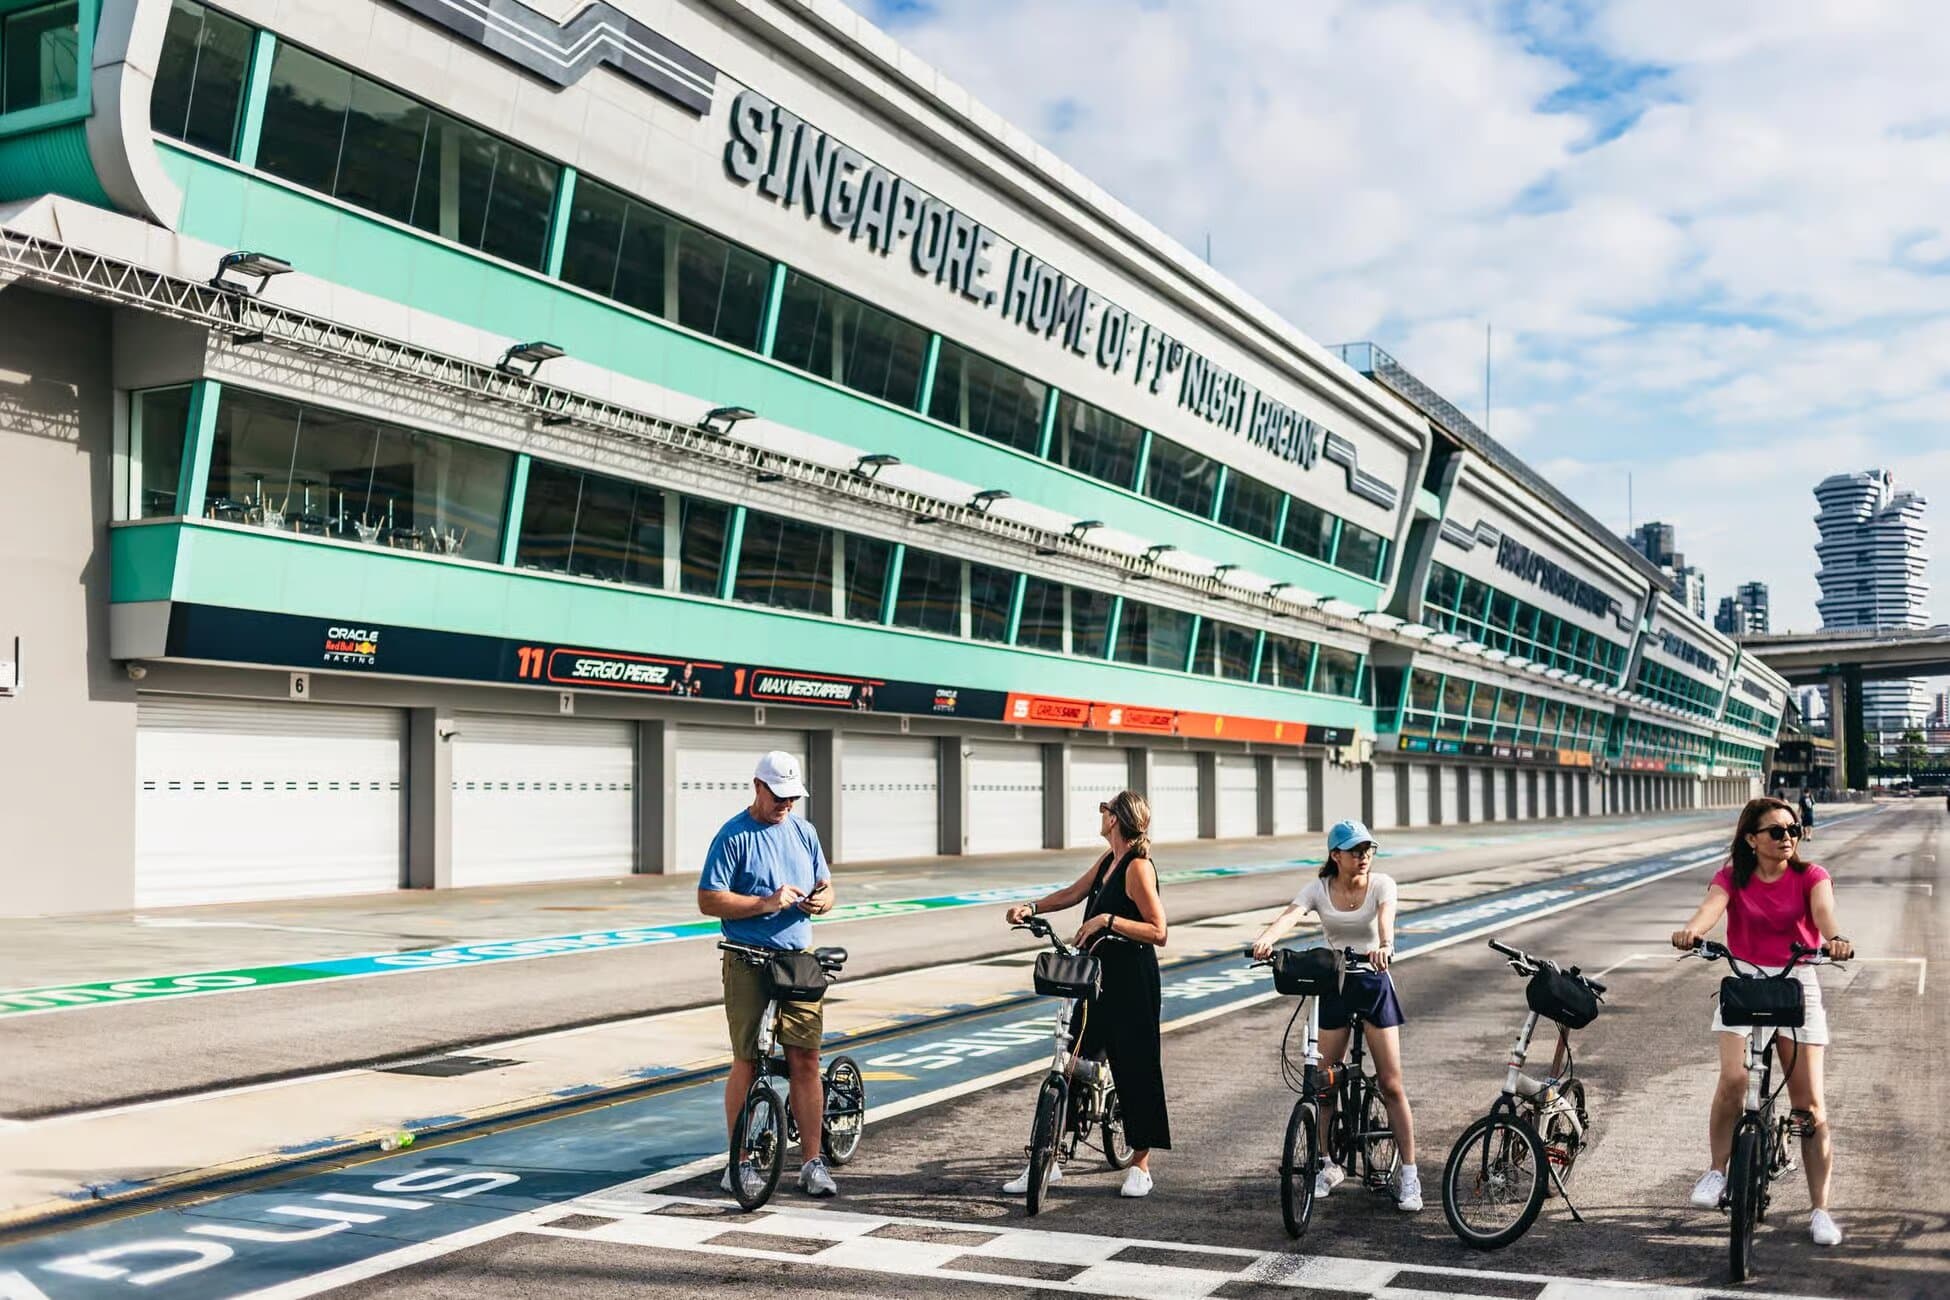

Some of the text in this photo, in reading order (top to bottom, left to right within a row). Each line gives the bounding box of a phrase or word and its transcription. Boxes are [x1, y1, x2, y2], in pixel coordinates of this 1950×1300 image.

[1000, 247, 1096, 360] HOME
[1096, 302, 1138, 375] OF
[1178, 351, 1254, 437] NIGHT
[1246, 389, 1322, 472] RACING
[325, 639, 341, 651] Red
[328, 627, 379, 642] ORACLE
[323, 653, 375, 665] RACING
[518, 647, 545, 678] 11
[571, 659, 669, 684] SERGIO PEREZ
[733, 668, 747, 696] 1
[295, 678, 305, 694] 6
[758, 677, 853, 700] MAX VERSTAPPEN
[563, 697, 570, 710] 7
[374, 931, 677, 966] aramco
[0, 976, 256, 1012] mco
